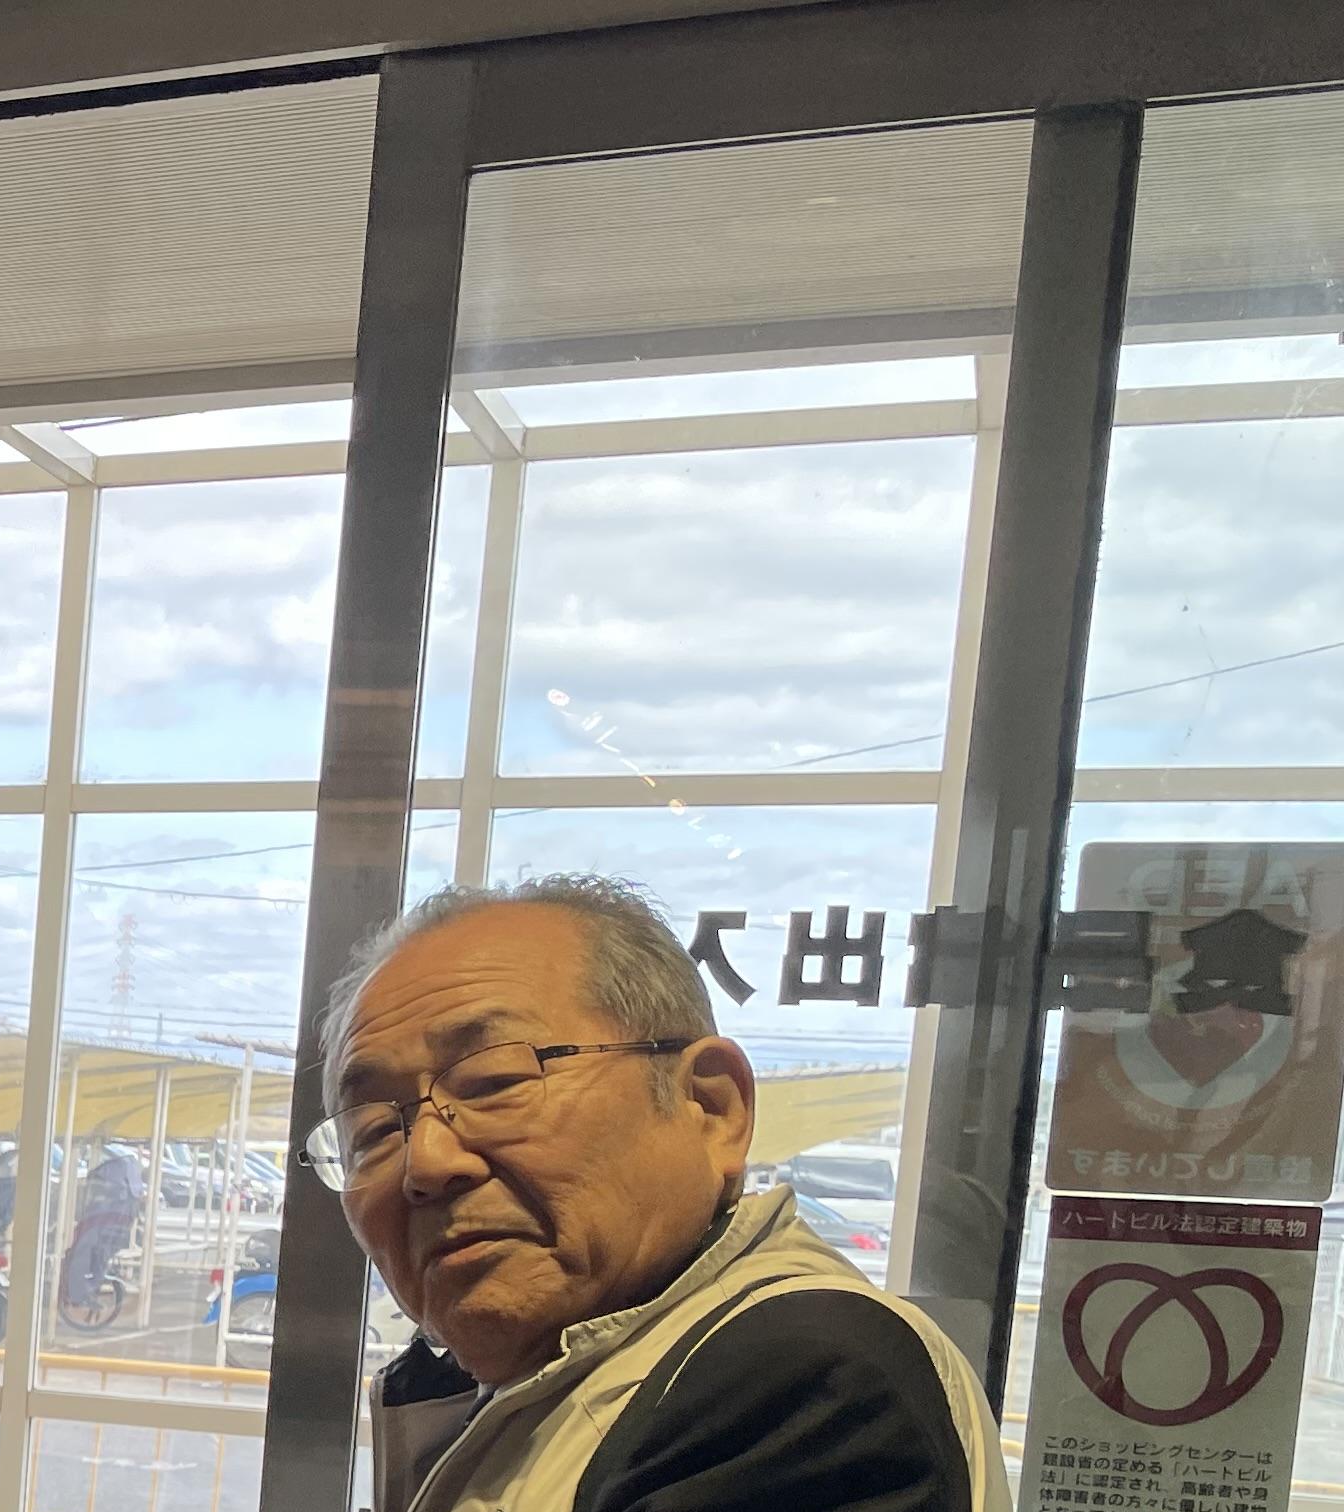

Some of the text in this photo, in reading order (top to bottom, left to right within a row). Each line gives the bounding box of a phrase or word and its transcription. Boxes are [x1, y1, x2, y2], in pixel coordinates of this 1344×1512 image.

[1062, 1209, 1308, 1239] ハートビル法認定建築物
[1045, 1436, 1273, 1465] このショッピングセンターは
